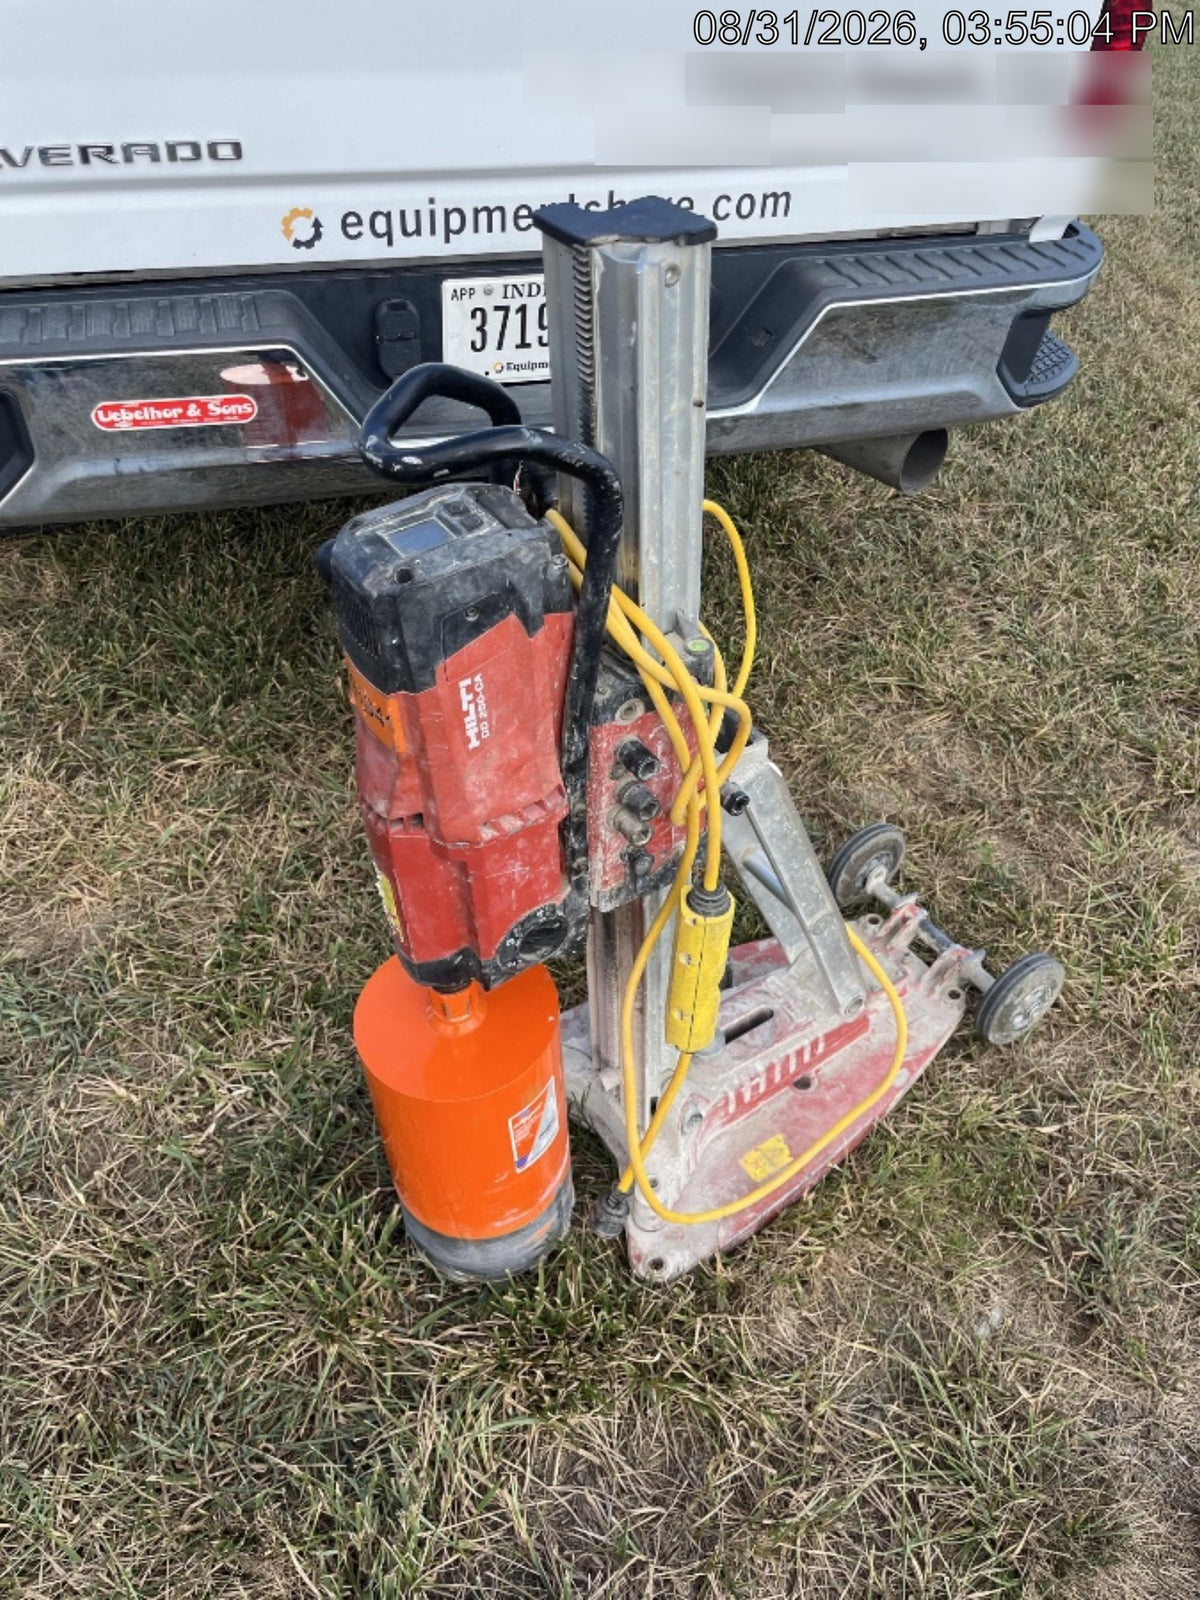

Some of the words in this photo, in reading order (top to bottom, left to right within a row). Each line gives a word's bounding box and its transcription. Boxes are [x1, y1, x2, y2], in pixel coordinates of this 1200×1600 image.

[0, 139, 243, 168] VERADO
[451, 287, 476, 301] APP
[502, 282, 547, 299] IND
[187, 403, 202, 418] &
[207, 401, 253, 416] Sons
[458, 678, 481, 751] HILTI
